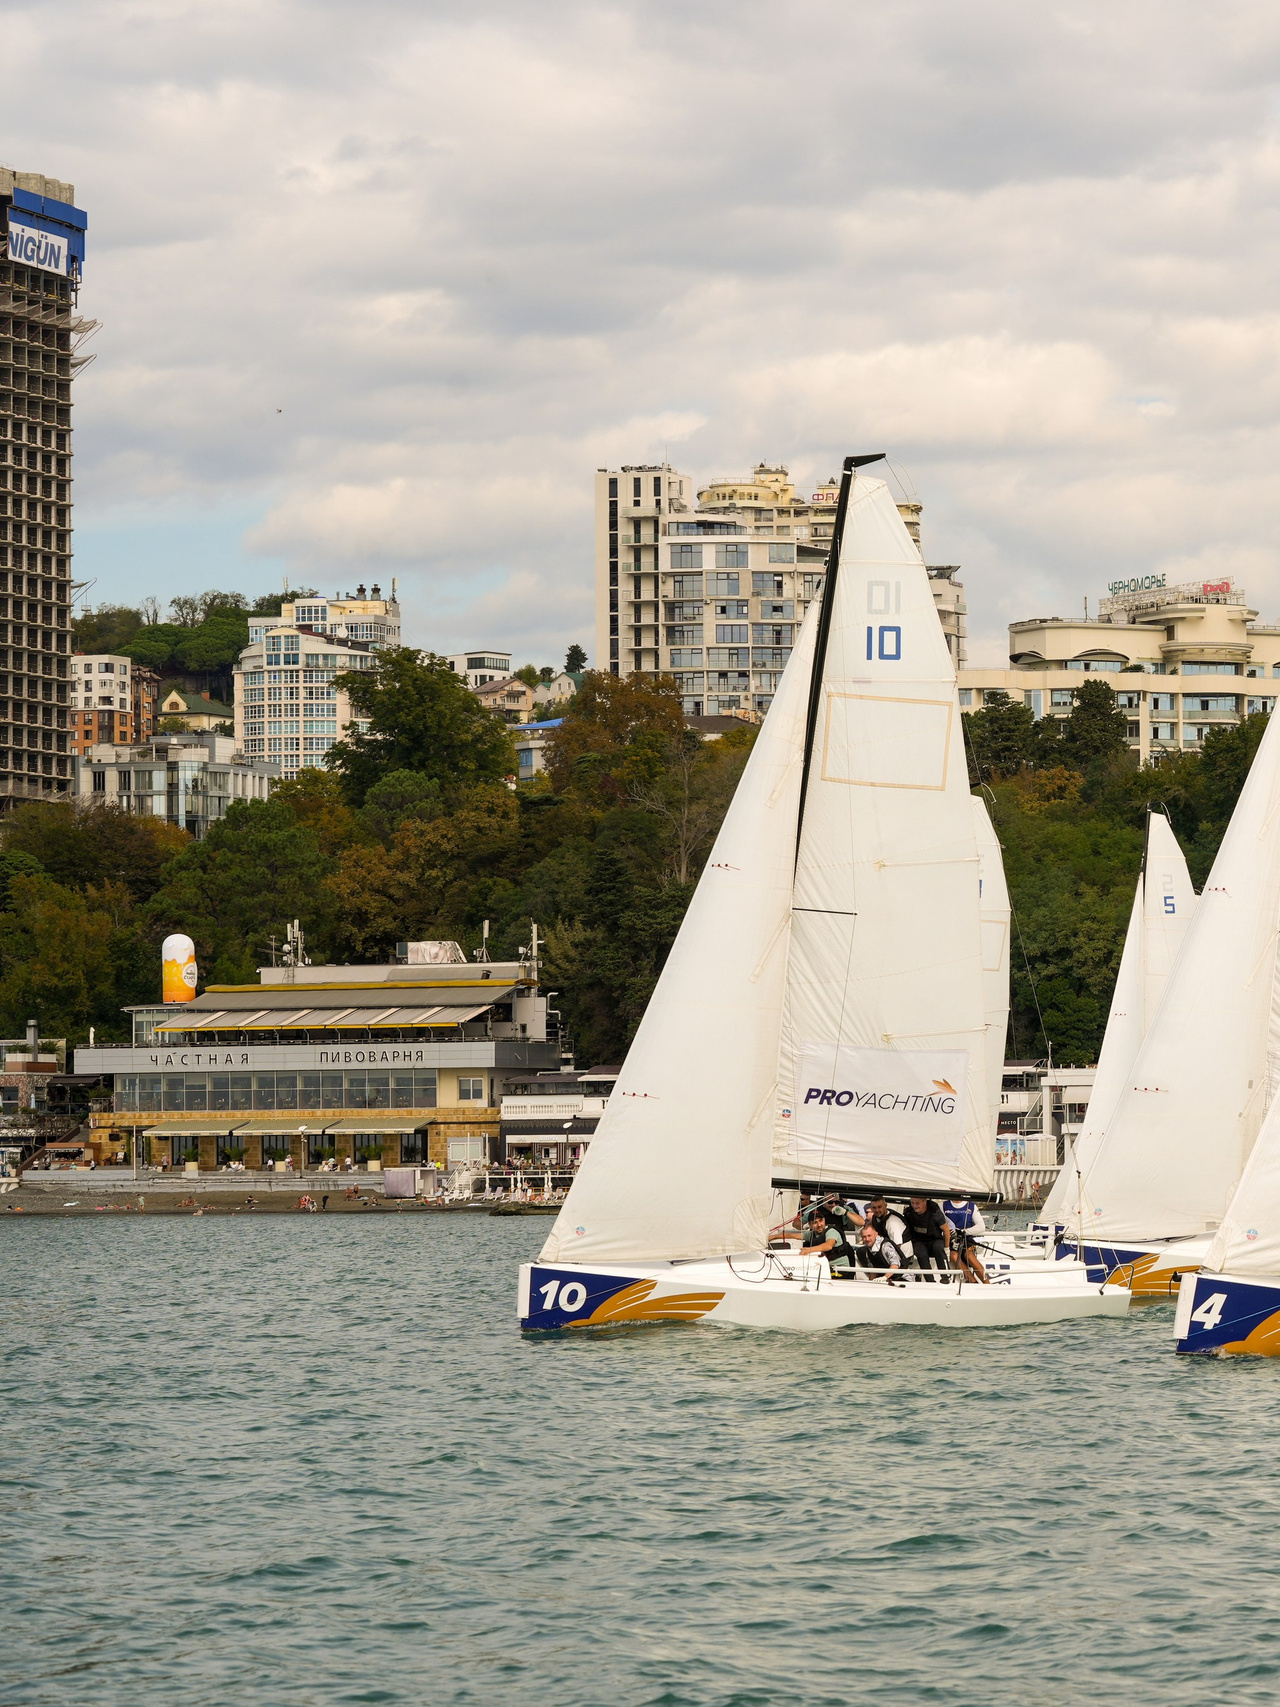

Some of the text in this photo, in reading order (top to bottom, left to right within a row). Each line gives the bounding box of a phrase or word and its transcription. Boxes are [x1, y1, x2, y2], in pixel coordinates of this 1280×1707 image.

[1108, 574, 1166, 595] ЧЕРНОМОРЬЕ
[866, 625, 901, 660] 10
[1163, 895, 1175, 914] 5
[150, 1050, 424, 1066] ЧАСТНАЯ ПИВОВАРНЯ
[803, 1087, 956, 1114] PROYACHTING
[539, 1280, 587, 1313] 10
[1191, 1292, 1228, 1330] 4
